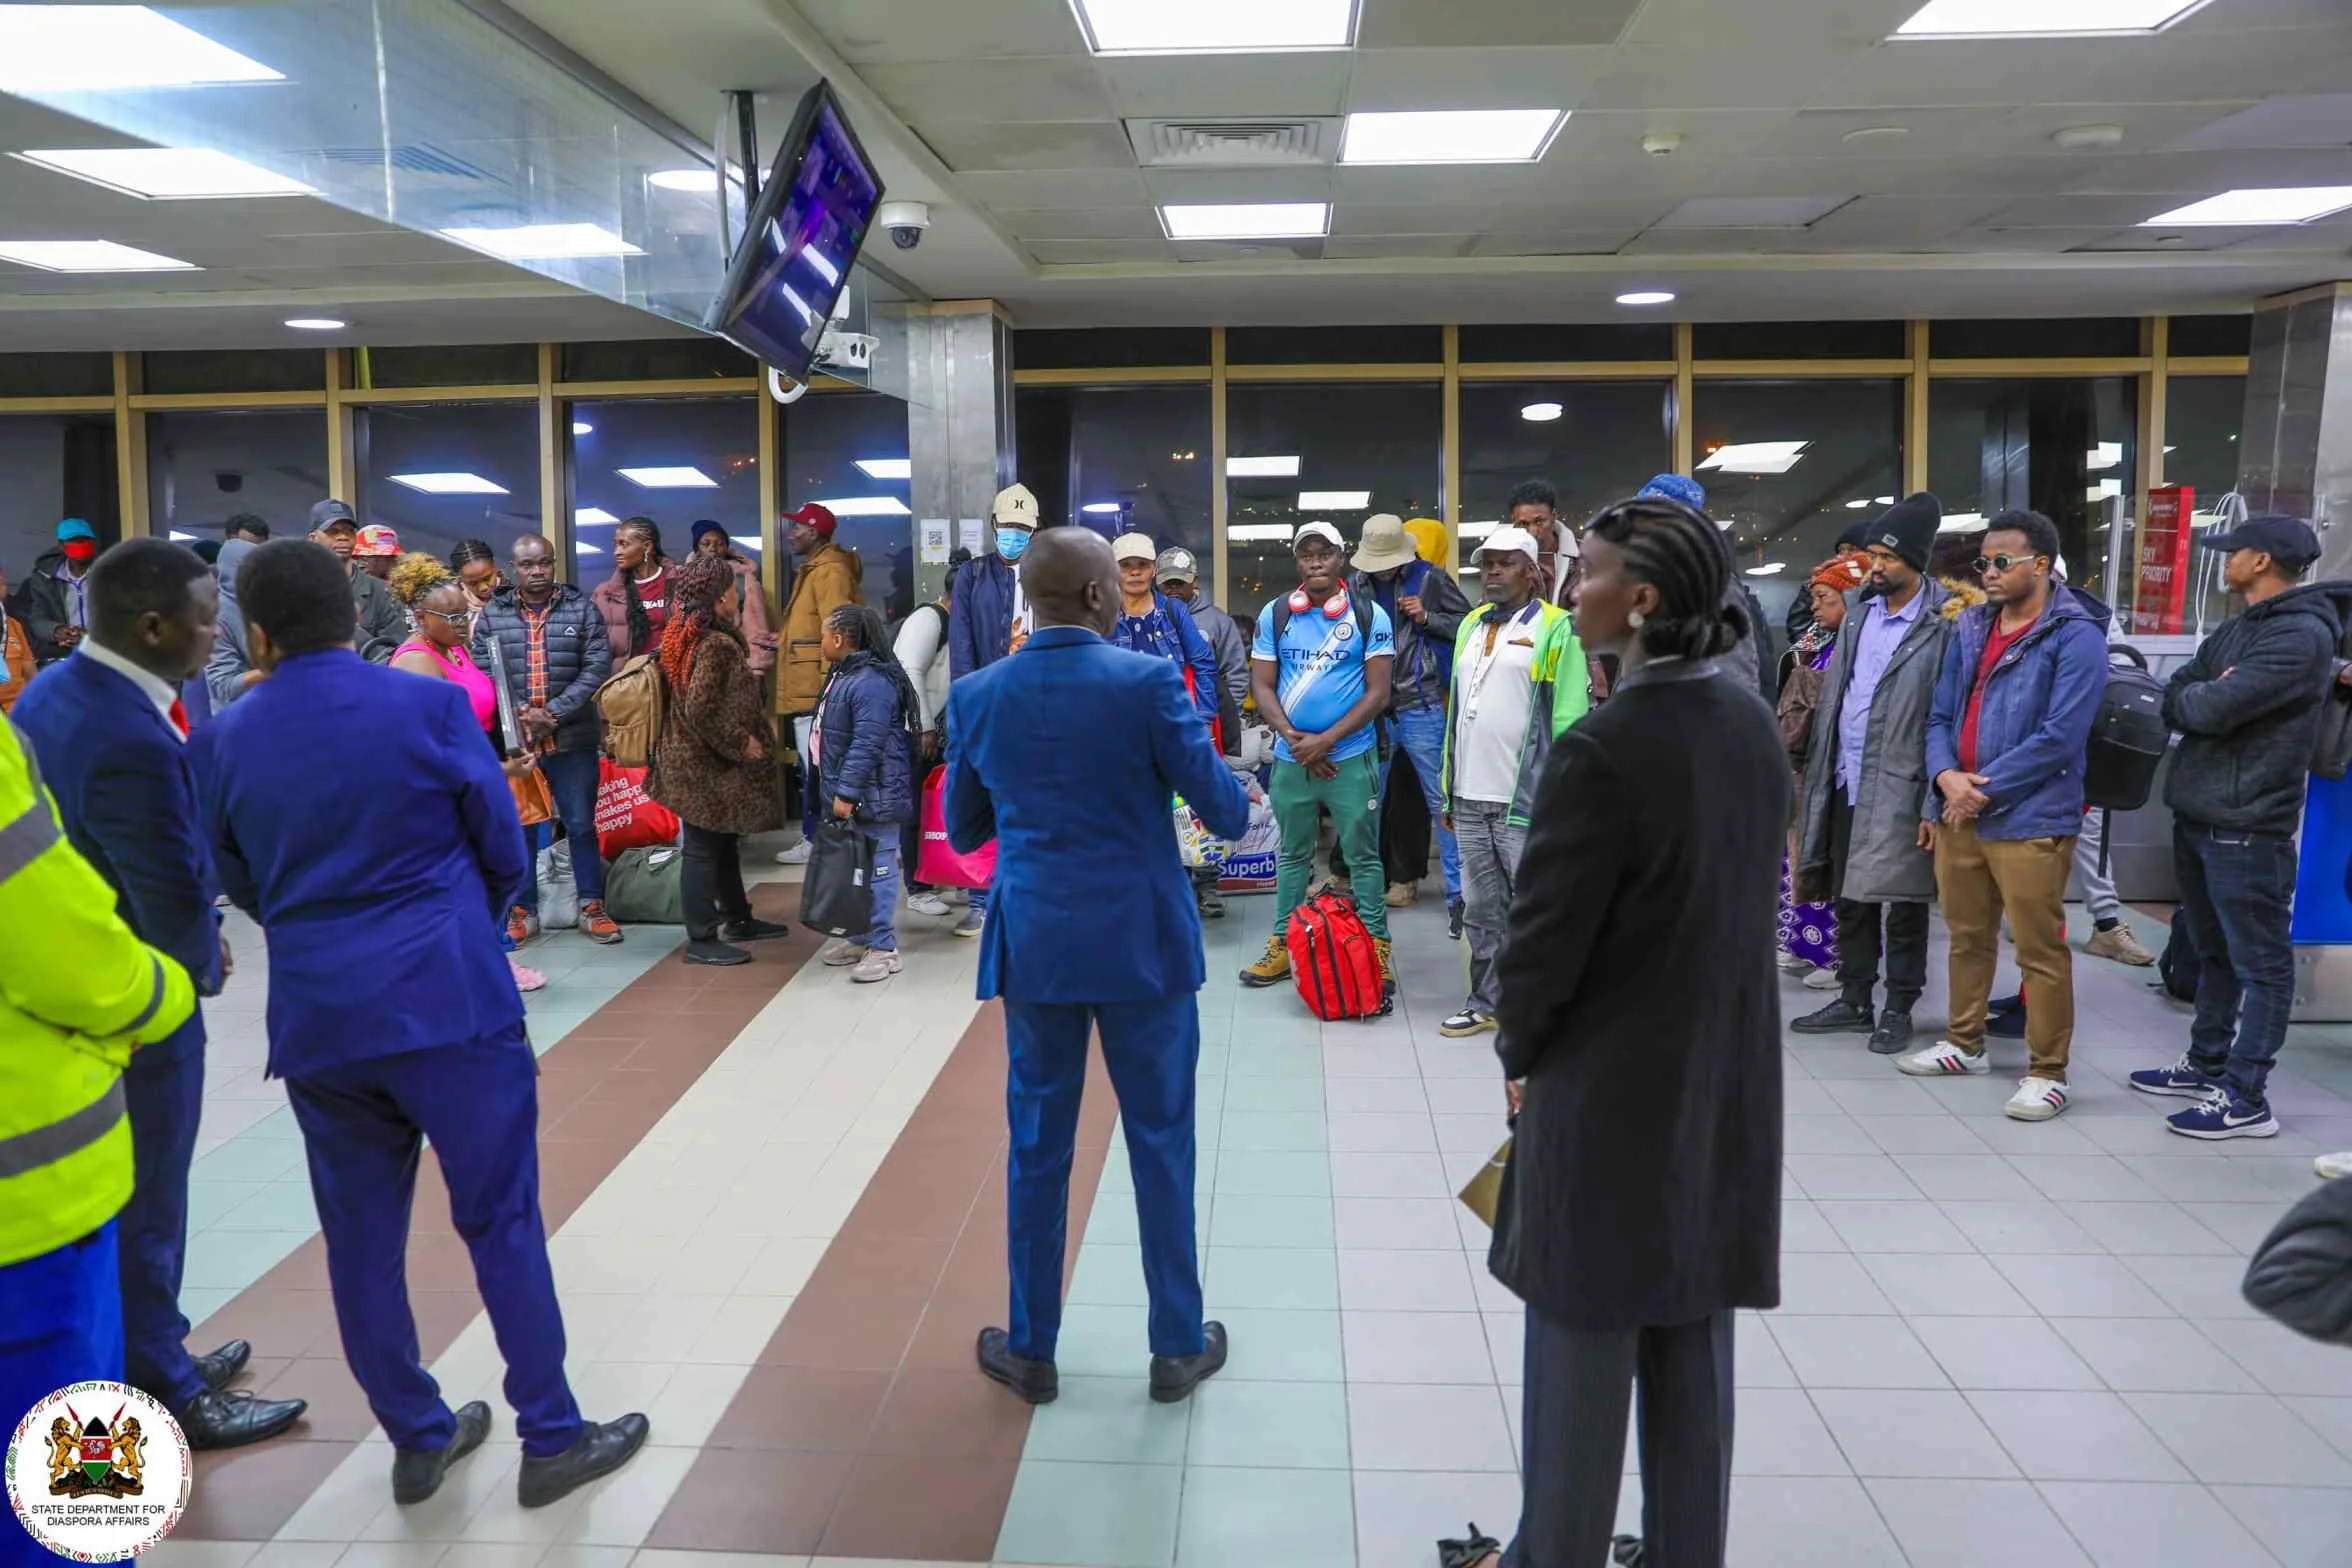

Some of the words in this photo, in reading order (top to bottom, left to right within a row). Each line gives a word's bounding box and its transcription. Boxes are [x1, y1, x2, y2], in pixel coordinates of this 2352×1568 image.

[2143, 547, 2156, 562] SKY
[2141, 565, 2172, 583] PRIORITY
[1281, 648, 1352, 660] ETIHAD
[598, 777, 629, 796] aking
[595, 797, 611, 808] ou
[613, 784, 642, 802] happ
[633, 794, 650, 805] us
[1217, 856, 1275, 877] Superb
